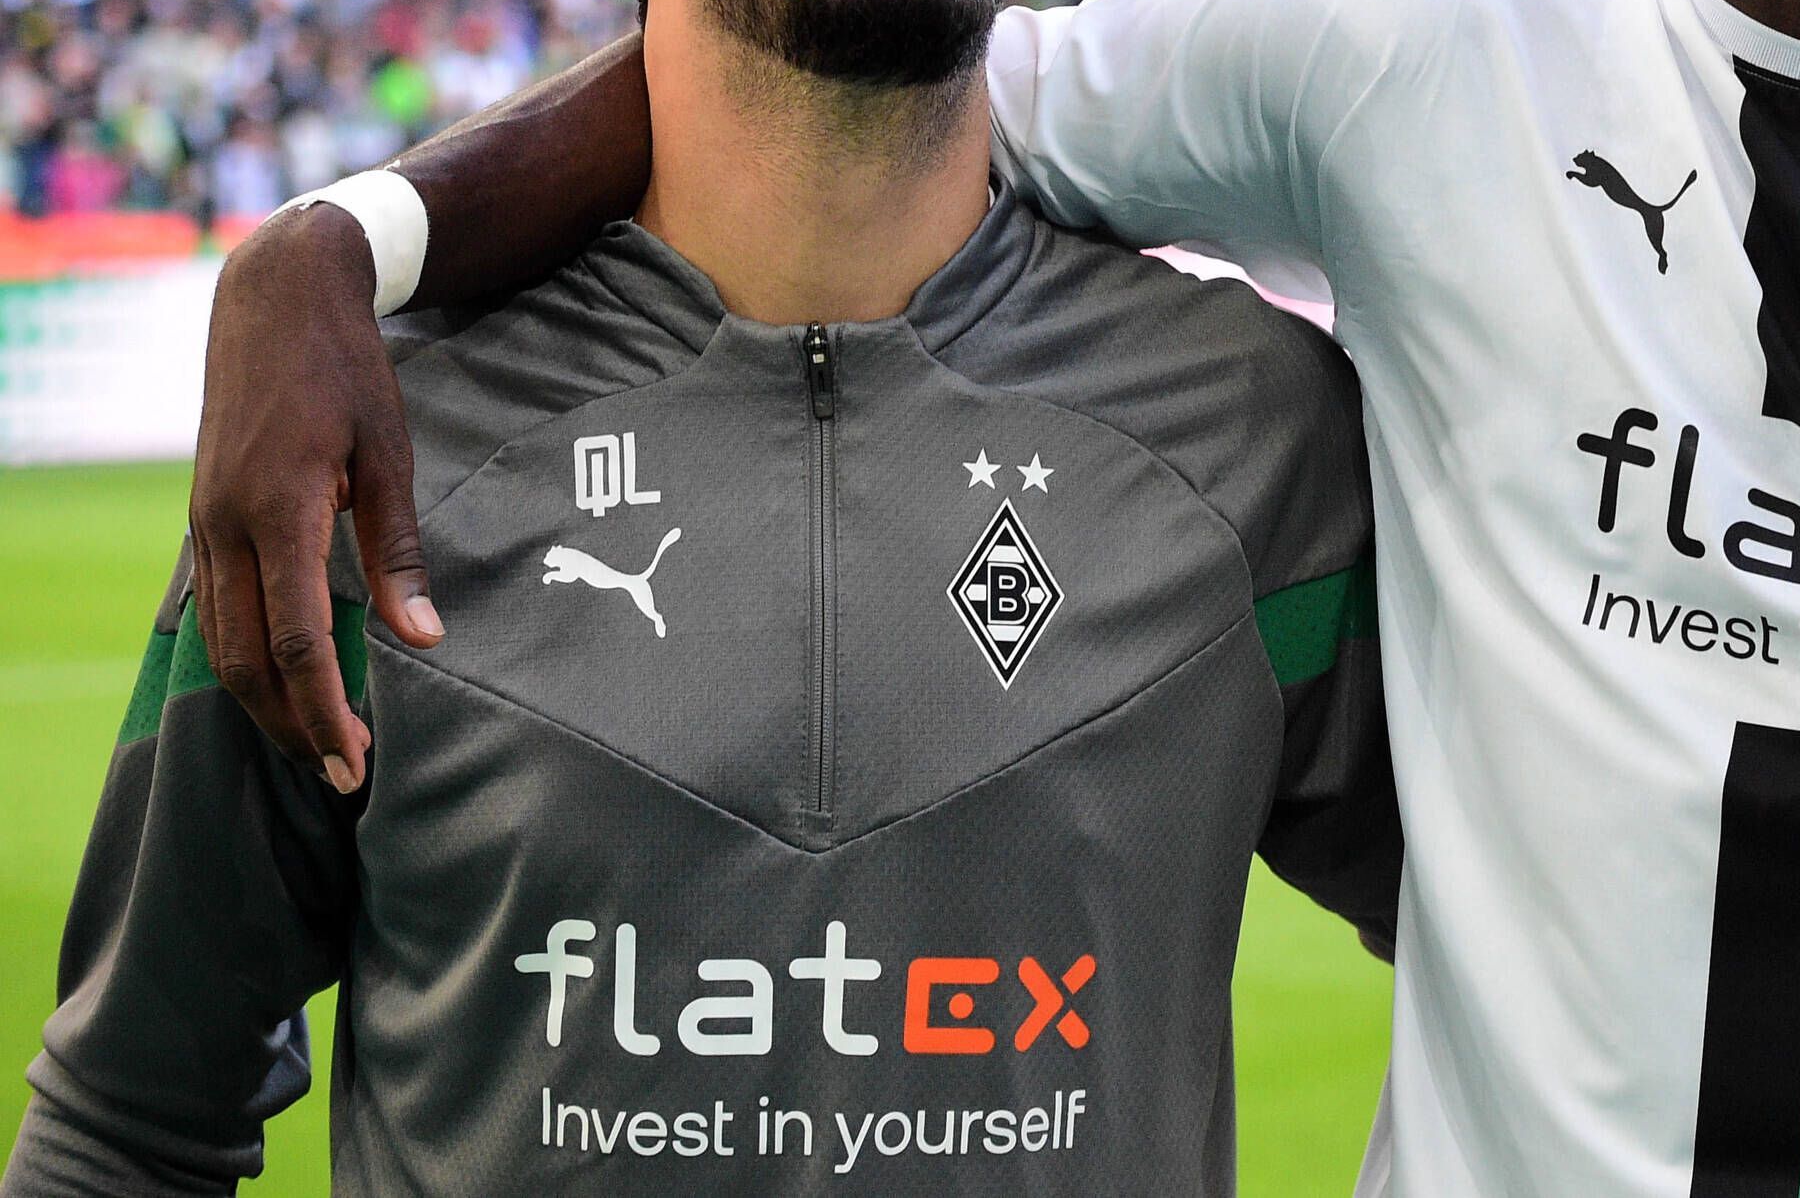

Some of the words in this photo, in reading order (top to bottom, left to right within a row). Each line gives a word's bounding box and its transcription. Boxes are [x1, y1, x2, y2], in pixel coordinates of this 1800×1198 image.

[985, 560, 1035, 627] B
[1582, 573, 1780, 665] Invest
[541, 1087, 734, 1156] Invest
[758, 1096, 813, 1156] in
[834, 1089, 1087, 1174] yourself
